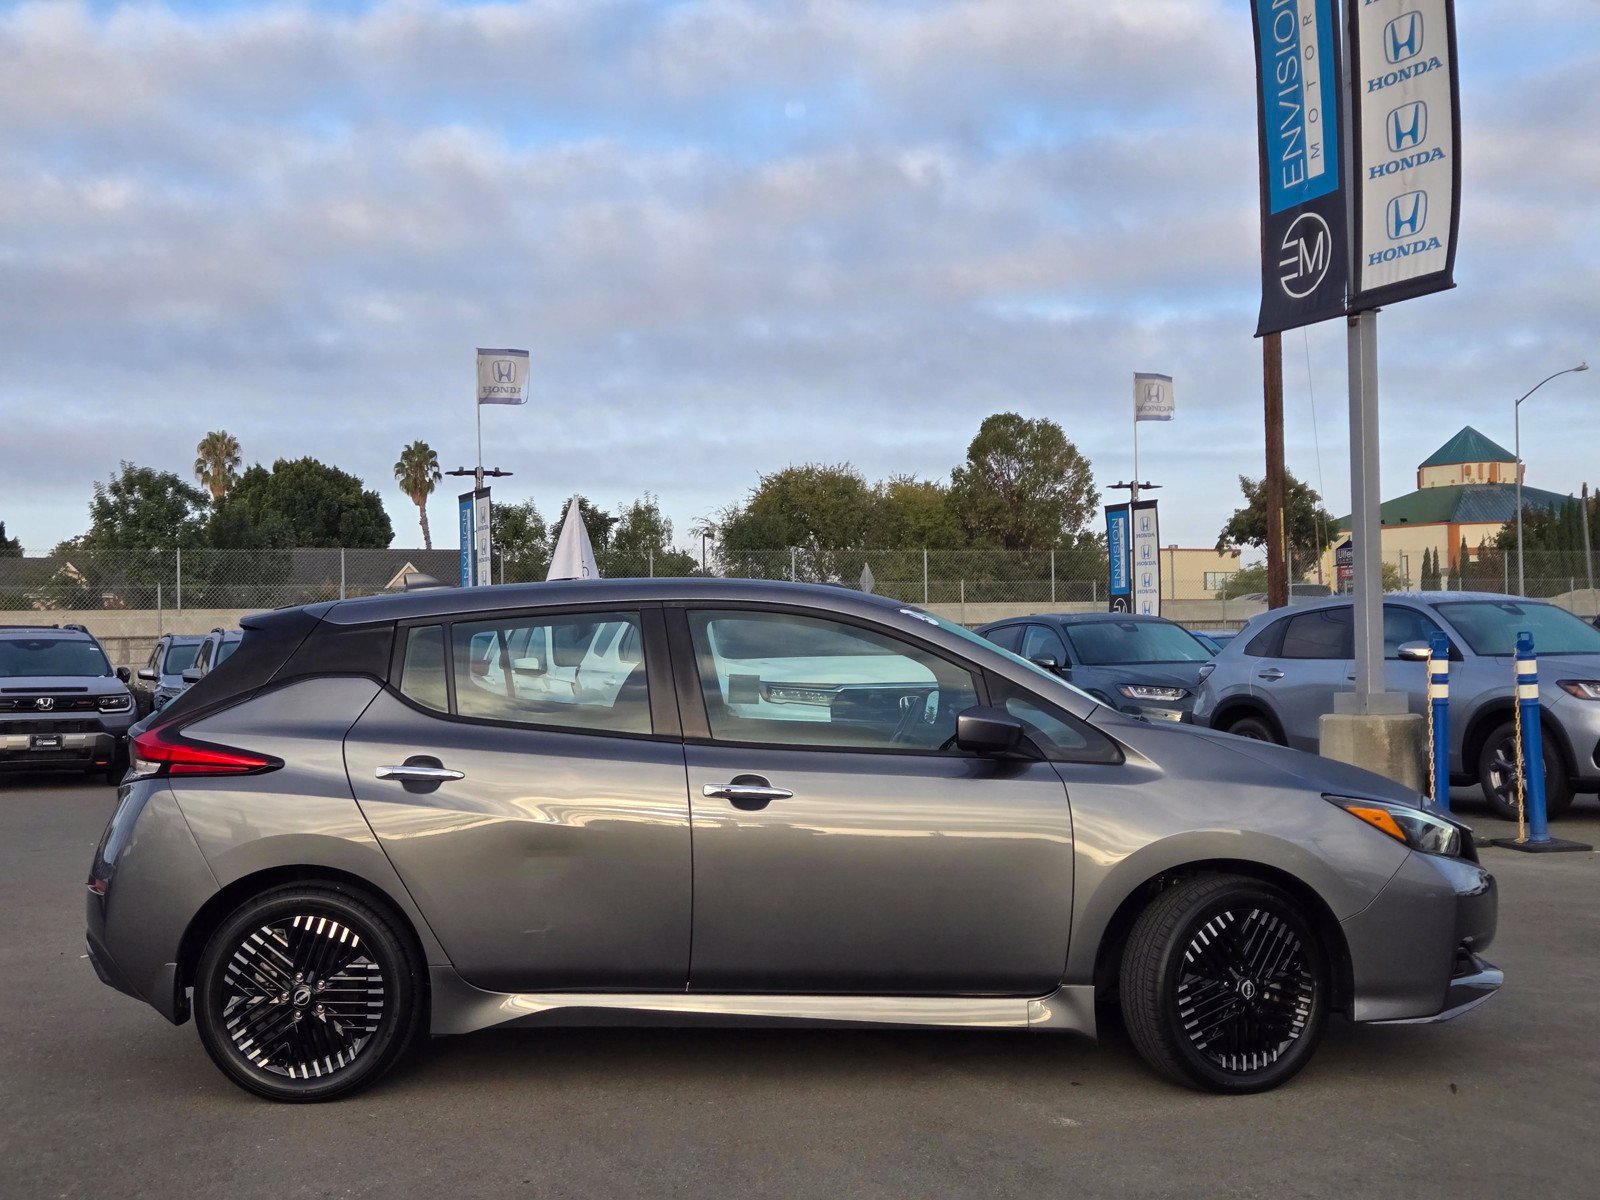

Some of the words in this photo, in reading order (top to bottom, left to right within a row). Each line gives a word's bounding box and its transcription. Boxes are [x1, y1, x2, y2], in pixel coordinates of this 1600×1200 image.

[1367, 56, 1443, 93] HONDA
[1368, 147, 1446, 180] HONDA
[1368, 236, 1442, 267] HONDA
[1112, 518, 1121, 589] ENVISION
